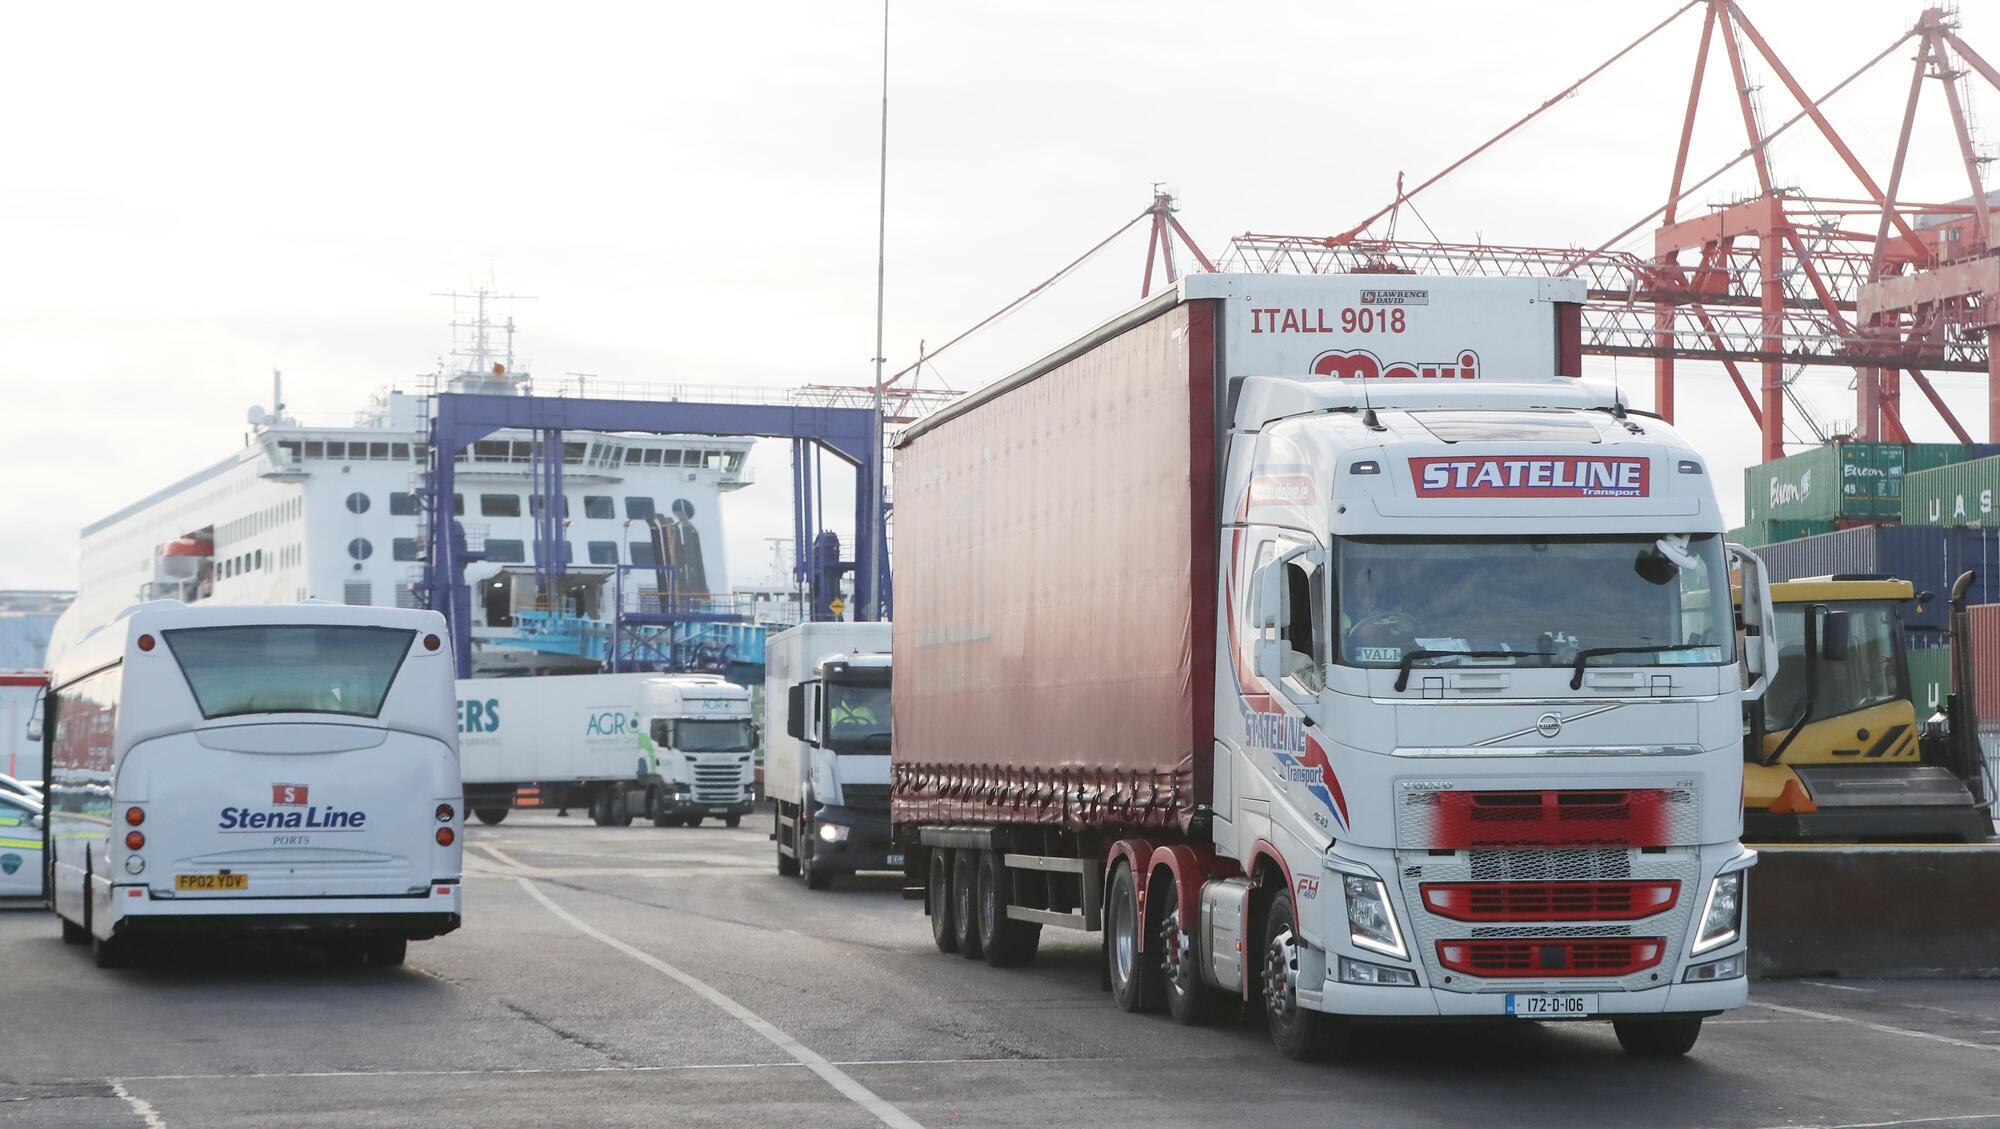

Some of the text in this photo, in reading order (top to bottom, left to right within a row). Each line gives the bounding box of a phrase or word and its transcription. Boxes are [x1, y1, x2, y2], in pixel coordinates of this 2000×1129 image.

[1251, 307, 1406, 334] ITALL 9018
[1423, 461, 1641, 489] STATELINE
[1581, 488, 1641, 497] Transport
[1844, 484, 1856, 494] 45
[1245, 712, 1305, 752] STATELINE
[1286, 763, 1324, 787] Transport
[284, 786, 296, 803] S
[218, 806, 366, 829] Stena Line
[272, 835, 310, 846] PORTS
[180, 874, 242, 888] FP02 YDV
[1297, 879, 1319, 896] FH
[1527, 997, 1584, 1012] 172-D-106
